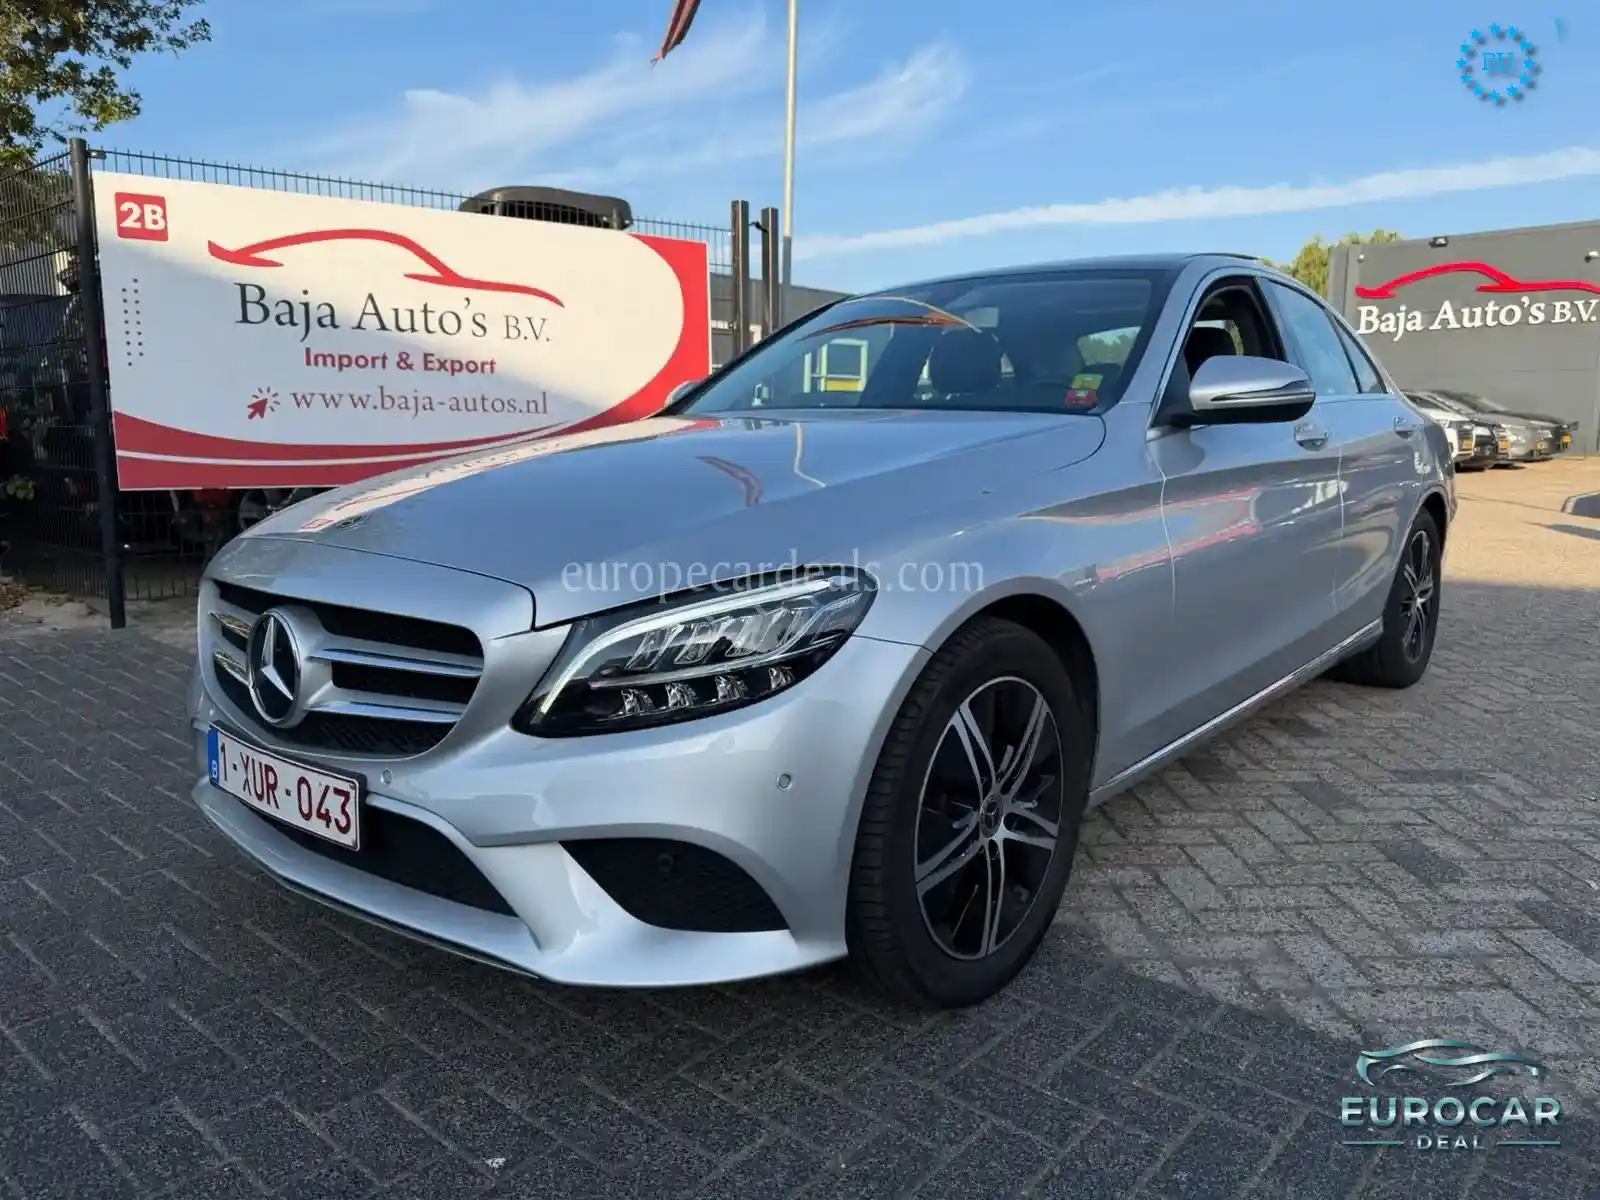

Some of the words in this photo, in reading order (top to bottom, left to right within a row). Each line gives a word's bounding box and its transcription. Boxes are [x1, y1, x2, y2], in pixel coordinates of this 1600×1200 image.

[119, 201, 166, 231] 2B
[233, 282, 341, 343] Baja
[351, 292, 489, 338] Auto's
[503, 314, 551, 342] B.V.
[1356, 304, 1424, 342] Baja
[1428, 296, 1546, 331] Auto's
[1551, 299, 1599, 324] B.V.
[304, 346, 389, 373] Import
[395, 351, 415, 371] &
[422, 352, 497, 377] Export
[290, 385, 549, 420] www.baja-autos.nl
[220, 741, 352, 835] 1-XUR-043
